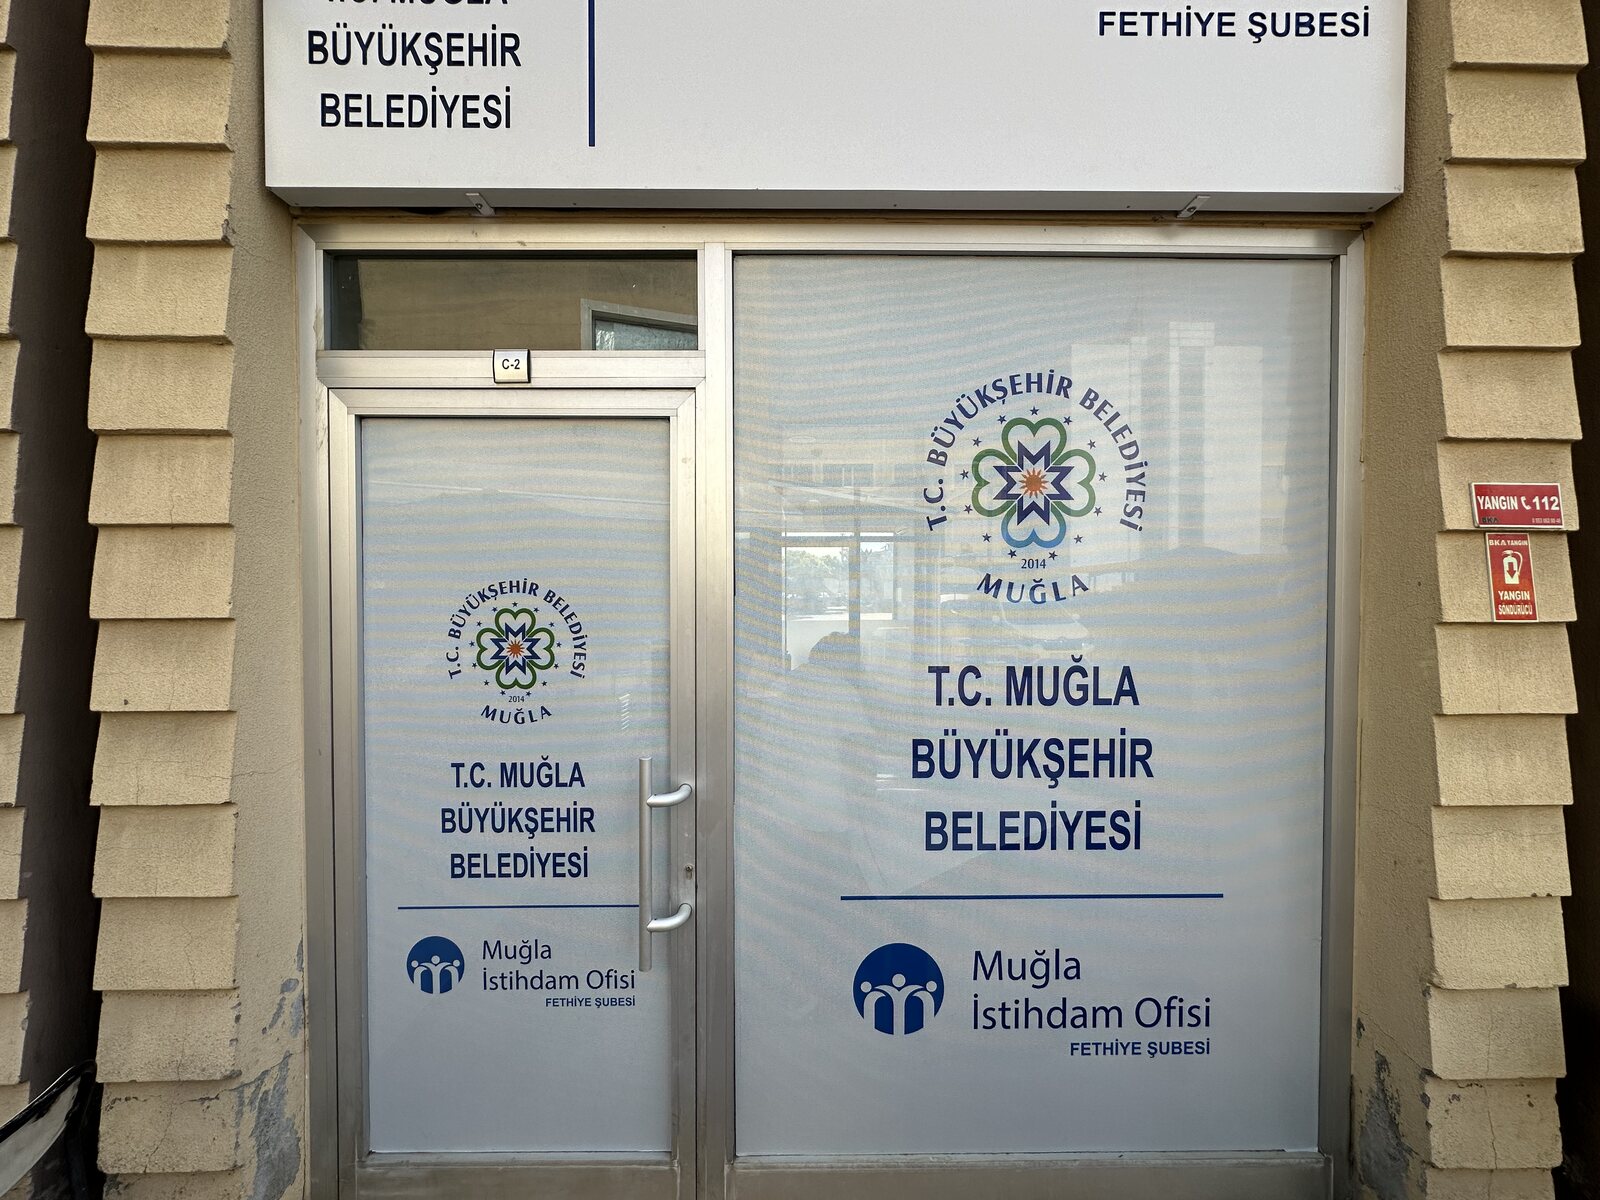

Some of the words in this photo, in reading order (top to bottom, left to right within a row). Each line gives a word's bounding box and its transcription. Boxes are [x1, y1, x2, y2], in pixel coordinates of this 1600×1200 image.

[1098, 5, 1236, 37] FETHİYE
[1247, 5, 1370, 44] ŞUBESİ
[307, 22, 522, 76] BÜYÜKŞEHİR
[320, 85, 512, 129] BELEDİYESİ
[501, 358, 521, 370] C-2
[926, 368, 1073, 467] BÜYÜKŞEHİR
[1078, 387, 1149, 532] BELEDİYESİ
[923, 478, 948, 531] T.C.
[1477, 495, 1518, 511] YANGIN
[1532, 495, 1560, 511] 112
[1020, 558, 1046, 569] 2014
[976, 572, 1089, 605] MUĞLA
[1498, 590, 1530, 601] YANGIN
[448, 578, 540, 640] BÜYÜKŞEHİR
[1498, 602, 1533, 615] SÖNDÜRÜCÜ
[543, 589, 588, 679] BELEDİYESİ
[446, 646, 462, 679] T.C.
[928, 665, 992, 706] T.C.
[1006, 654, 1140, 706] MUĞLA
[480, 704, 552, 725] MUĞLA
[508, 695, 525, 703] 2014
[451, 762, 492, 788] T.C.
[500, 755, 585, 788] MUĞLA
[911, 727, 1154, 789] BÜYÜKŞEHİR
[441, 801, 596, 839] BÜYÜKŞEHİR
[925, 800, 1141, 851] BELEDİYESİ
[450, 846, 588, 879] BELEDİYESİ
[482, 938, 552, 965] Muğla
[482, 967, 579, 991] İstihdam
[586, 968, 636, 990] Ofisi
[972, 948, 1082, 989] Muğla
[545, 995, 592, 1007] FETHİYE
[594, 995, 636, 1008] ŞUBESİ
[972, 993, 1123, 1030] İstihdam
[1134, 995, 1211, 1028] Ofisi
[1069, 1038, 1142, 1056] FETHİYE
[1146, 1038, 1211, 1058] ŞUBESİ
